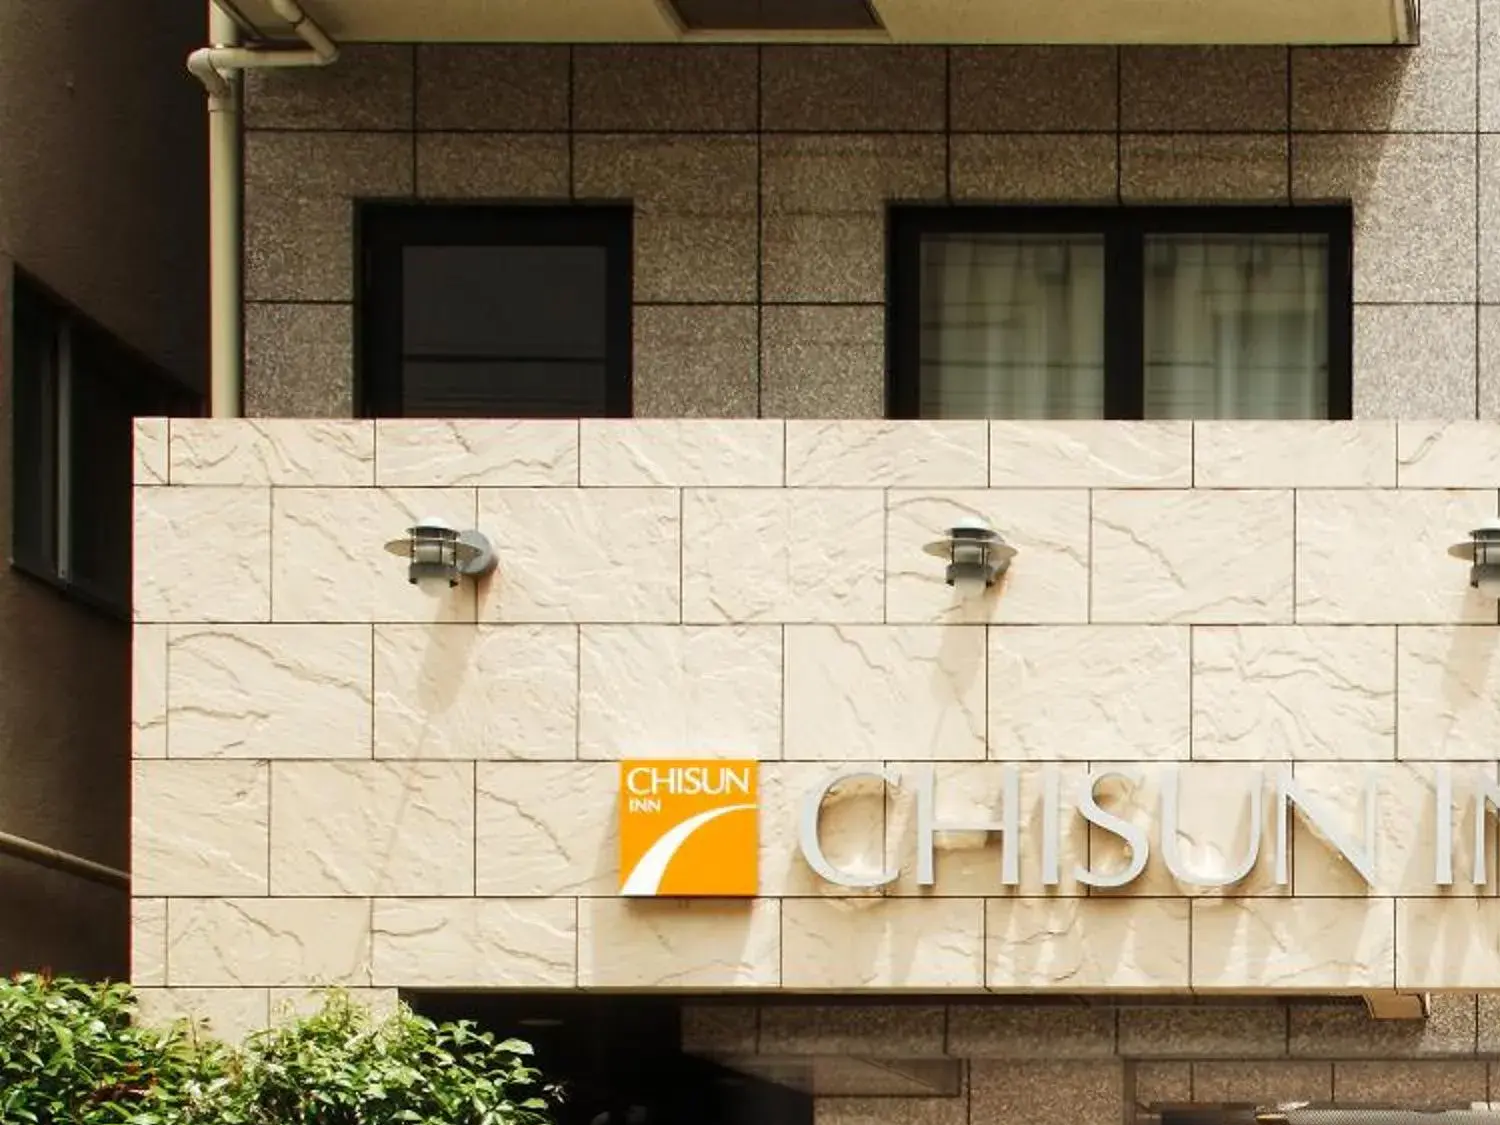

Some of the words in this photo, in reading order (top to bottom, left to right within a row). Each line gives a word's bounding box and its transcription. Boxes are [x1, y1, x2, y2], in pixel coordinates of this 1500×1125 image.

[627, 767, 750, 796] CHISUN
[629, 799, 661, 813] INN
[799, 770, 1378, 888] CHISUN
